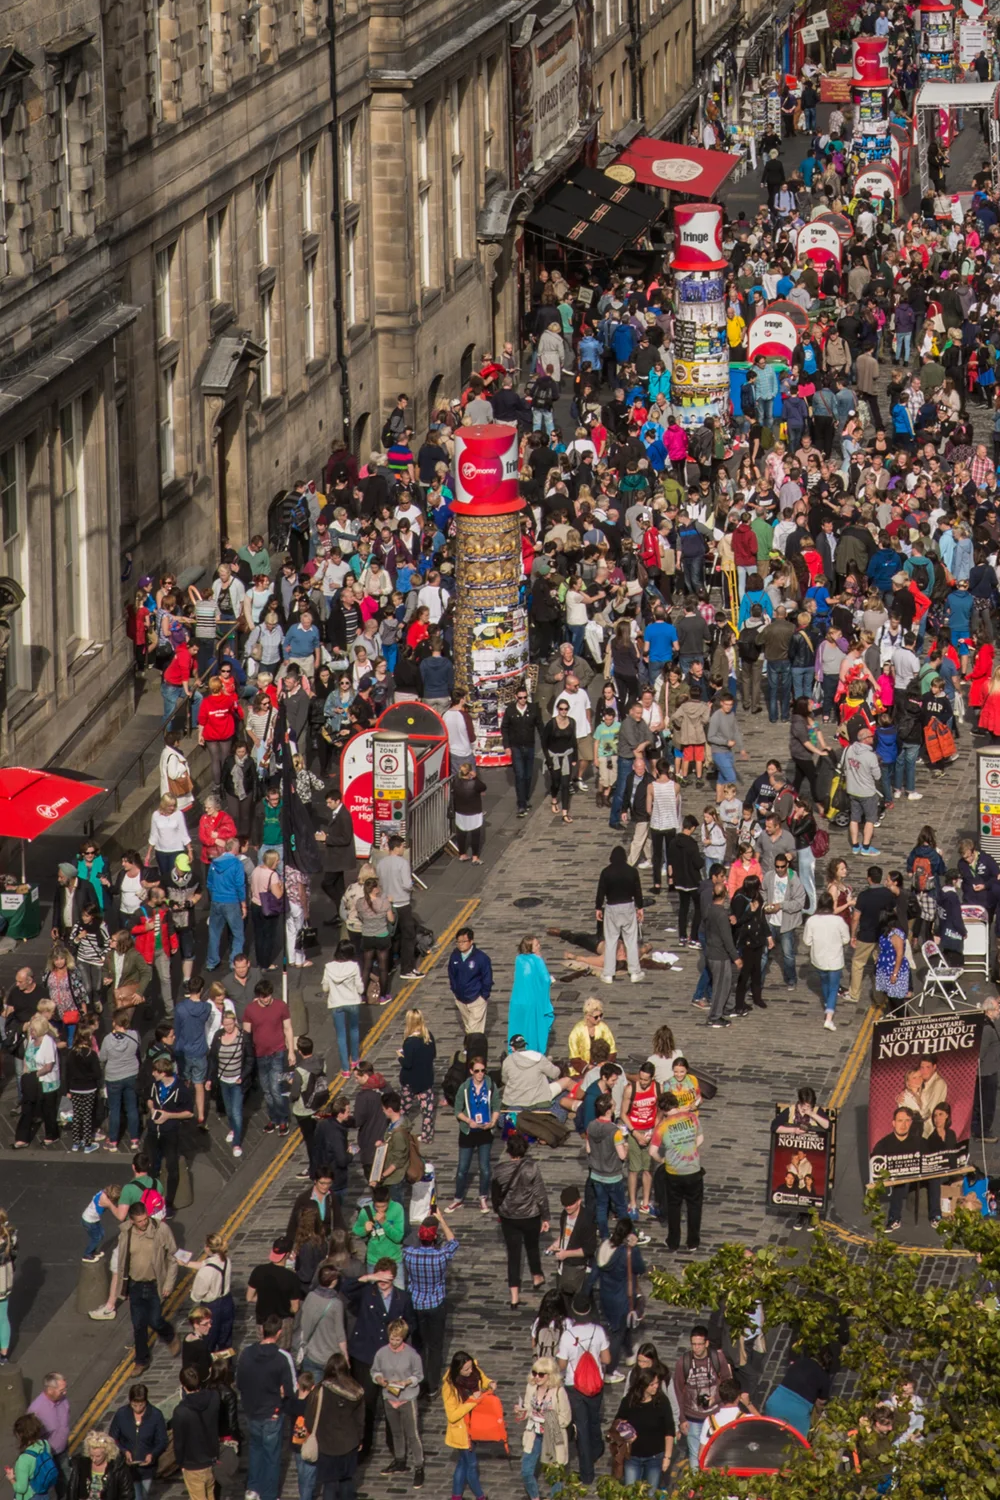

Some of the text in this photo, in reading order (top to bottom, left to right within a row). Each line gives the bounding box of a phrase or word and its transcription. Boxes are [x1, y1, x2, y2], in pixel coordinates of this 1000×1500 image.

[867, 177, 882, 185] fringe
[683, 232, 708, 243] fringe
[811, 228, 826, 236] fringe
[765, 320, 782, 329] fringe
[927, 701, 943, 712] GAP
[51, 797, 69, 810] money
[893, 1020, 965, 1033] STORY SHAKESPEARE:
[880, 1024, 977, 1043] MUCH ADO ABOUT
[878, 1033, 975, 1059] NOTHING
[668, 1117, 694, 1133] SHOUT!
[778, 1138, 824, 1150] NOTHING
[806, 1135, 824, 1143] ABOUT
[888, 1153, 913, 1161] venue
